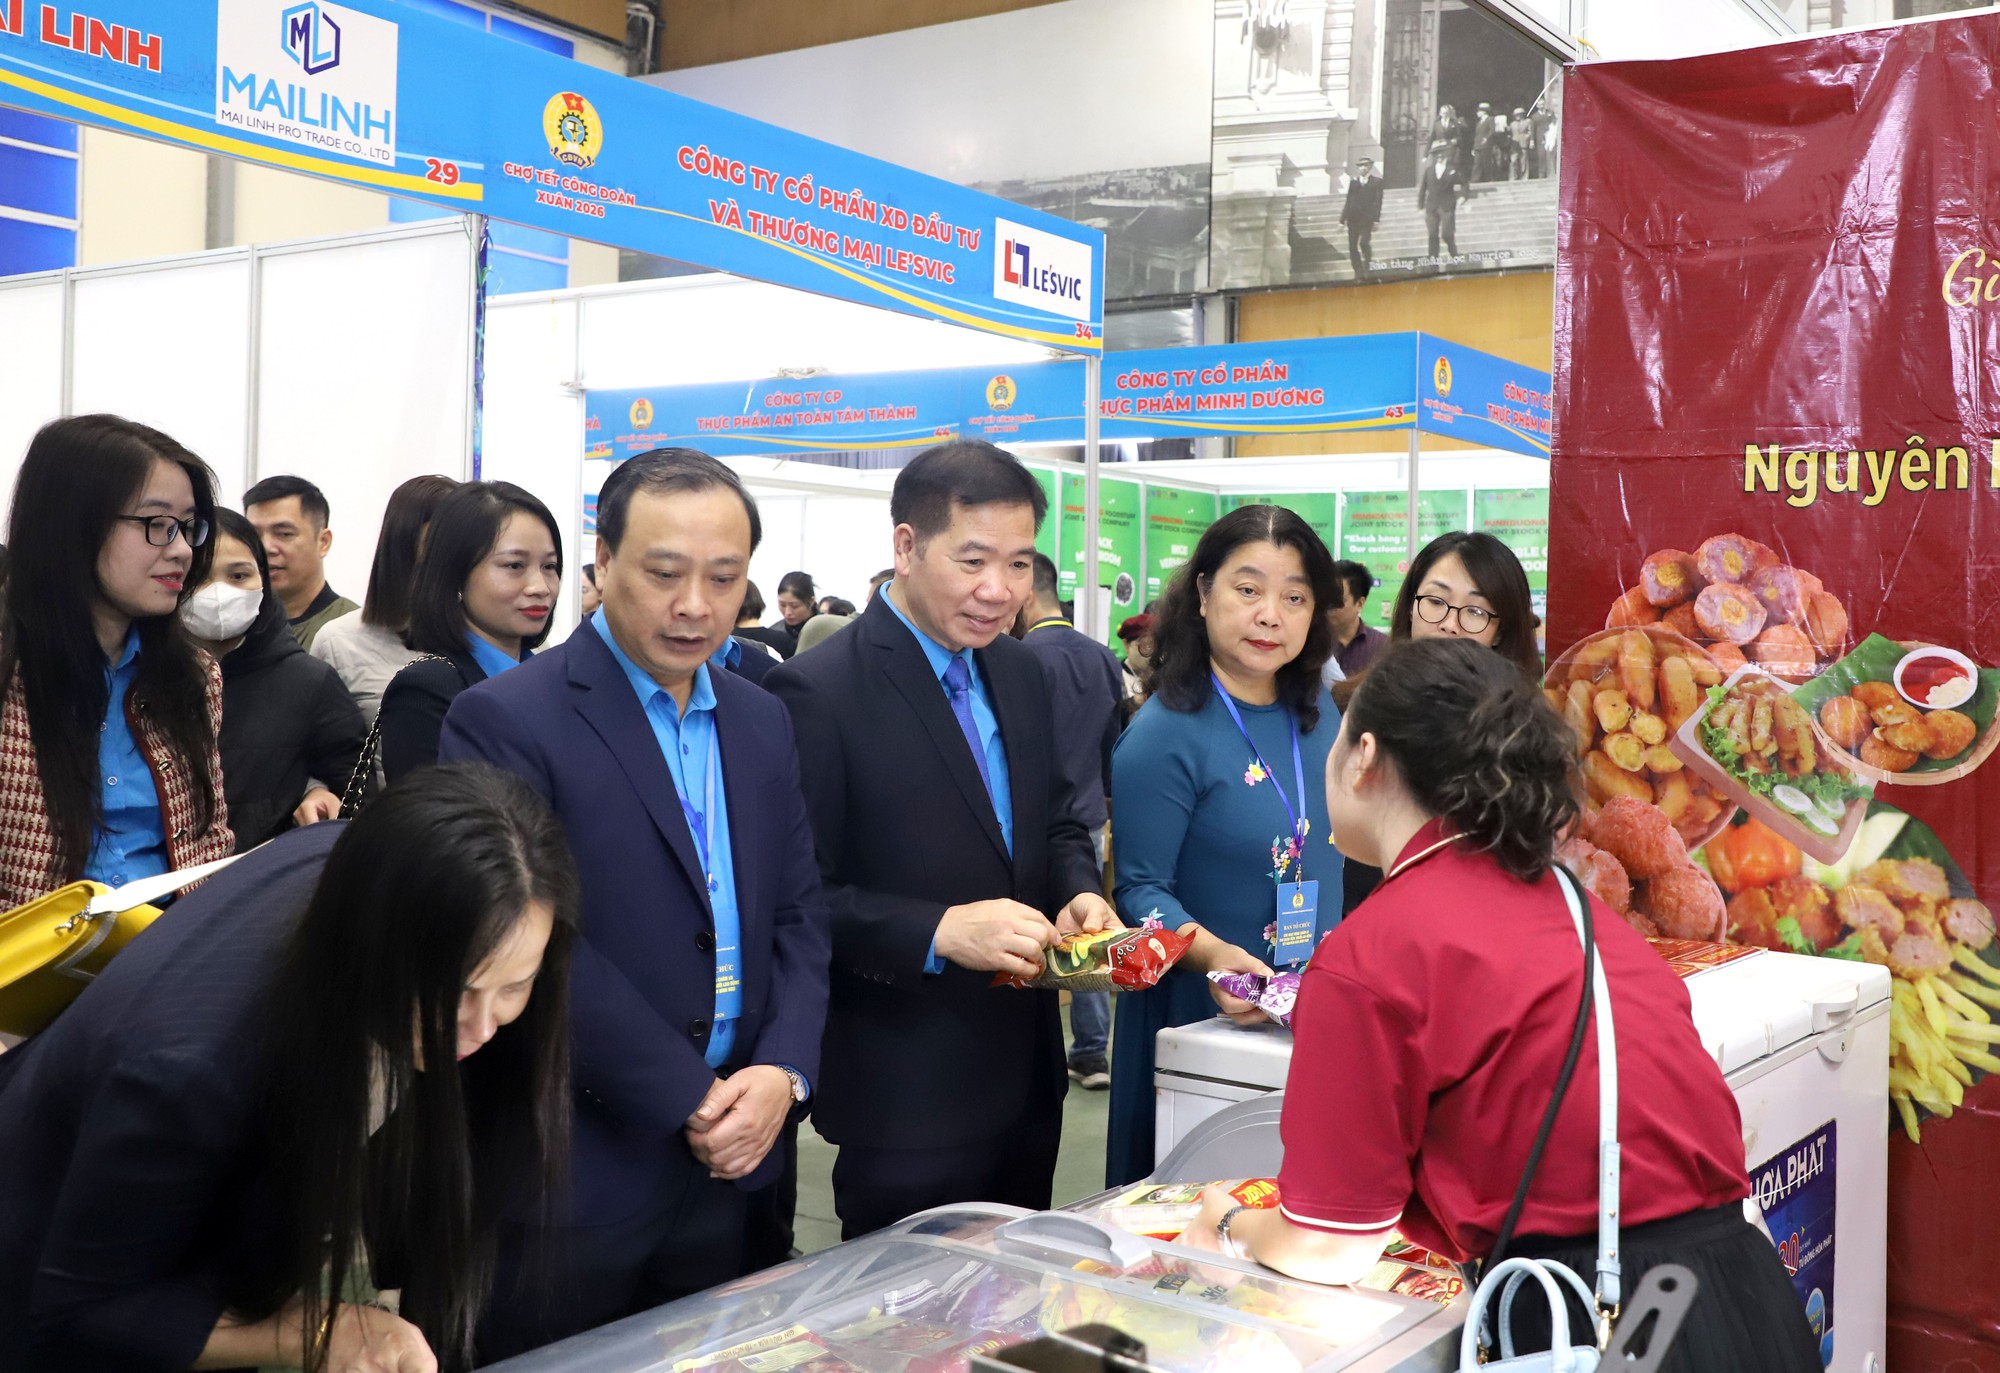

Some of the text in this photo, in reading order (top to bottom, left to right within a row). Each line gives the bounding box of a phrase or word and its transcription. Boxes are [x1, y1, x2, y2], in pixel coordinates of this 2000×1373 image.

[40, 4, 162, 73] LINH
[222, 65, 391, 145] MAILINH
[221, 110, 243, 124] MAI
[247, 115, 275, 133] LINH
[278, 124, 301, 139] PRO
[305, 131, 341, 149] TRADE
[370, 147, 391, 161] LTD
[425, 158, 459, 186] 29
[504, 162, 636, 206] CHỢ TẾT CÔNG ĐOÀN
[535, 189, 605, 218] XUÂN 2026
[677, 144, 982, 252] CÔNG TY CỔ PHẦN XD ĐẦU TƯ
[708, 198, 743, 231] VÀ
[747, 210, 839, 255] THƯƠNG
[844, 236, 881, 269] MẠI
[1075, 322, 1092, 340] 34
[1116, 359, 1289, 390] CÔNG TY CỔ PHẦN
[764, 390, 843, 408] CÔNG TY CP
[1136, 390, 1191, 413] PHẨM
[1196, 393, 1246, 411] MINH
[1251, 388, 1324, 408] DƯƠNG
[1503, 380, 1528, 405] CÔNG
[1530, 391, 1541, 409] TY
[697, 403, 917, 432] THỰC PHẨM AN TOÀN TÂM THÀNH
[1384, 406, 1404, 419] 43
[1744, 434, 1969, 507] Nguyên
[1787, 1133, 1827, 1196] PHÁT
